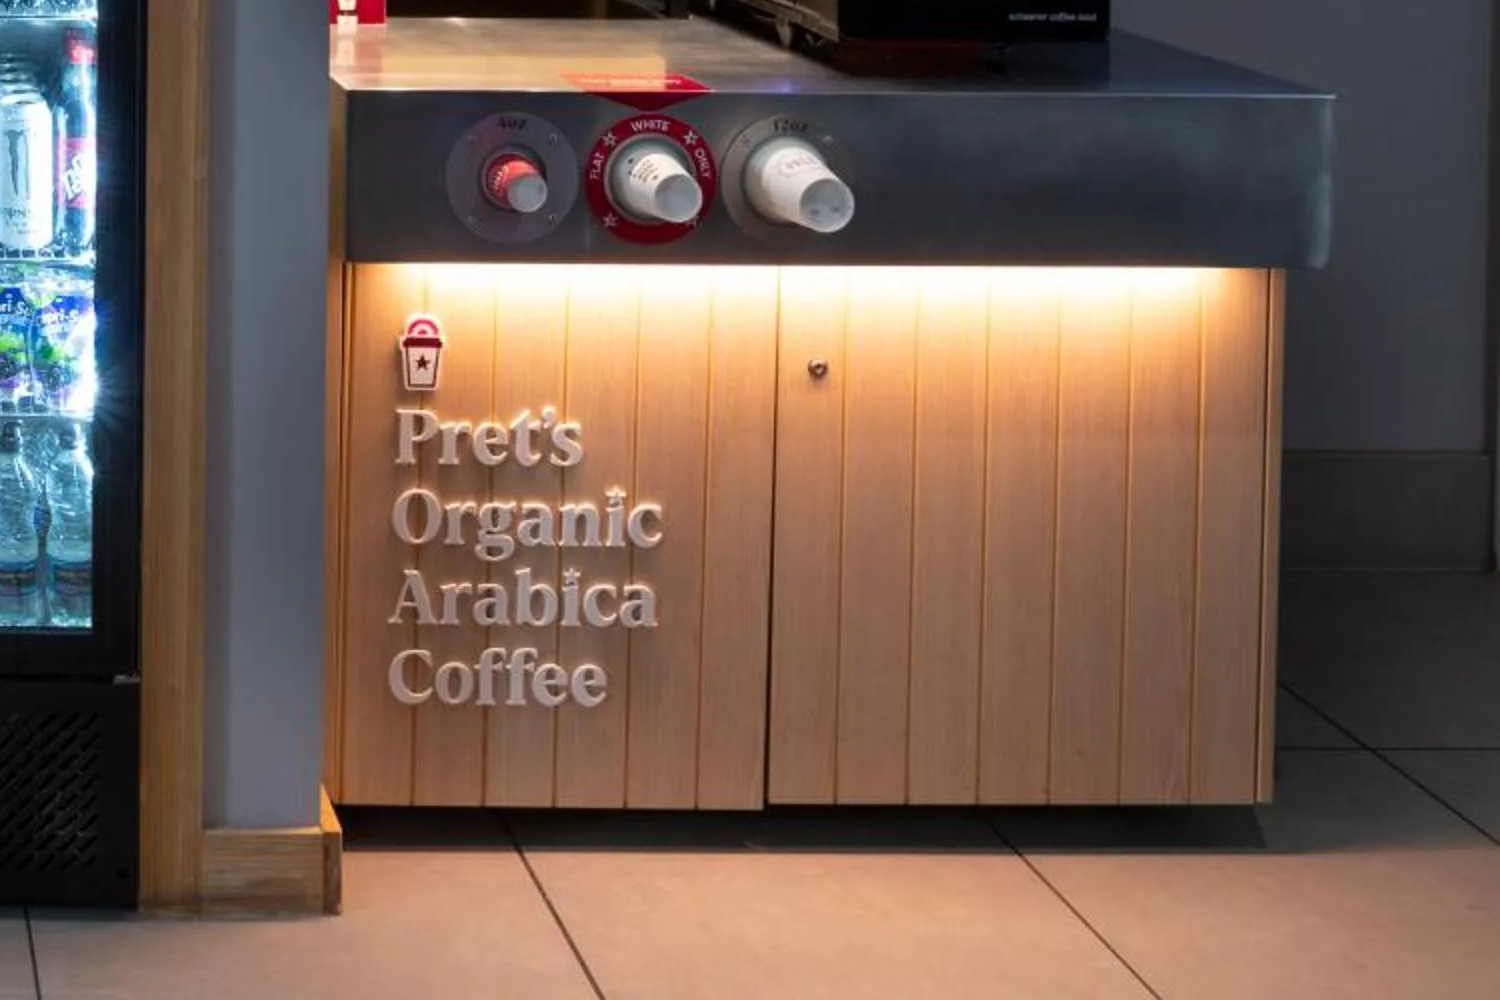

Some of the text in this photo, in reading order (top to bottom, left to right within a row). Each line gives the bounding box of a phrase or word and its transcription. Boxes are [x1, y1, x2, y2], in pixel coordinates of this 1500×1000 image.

[630, 119, 671, 133] WHITE
[694, 148, 712, 179] ONLY
[394, 406, 584, 467] Pret's
[391, 486, 664, 562] Organic
[388, 567, 659, 628] Arabica
[388, 647, 609, 707] Coffee
